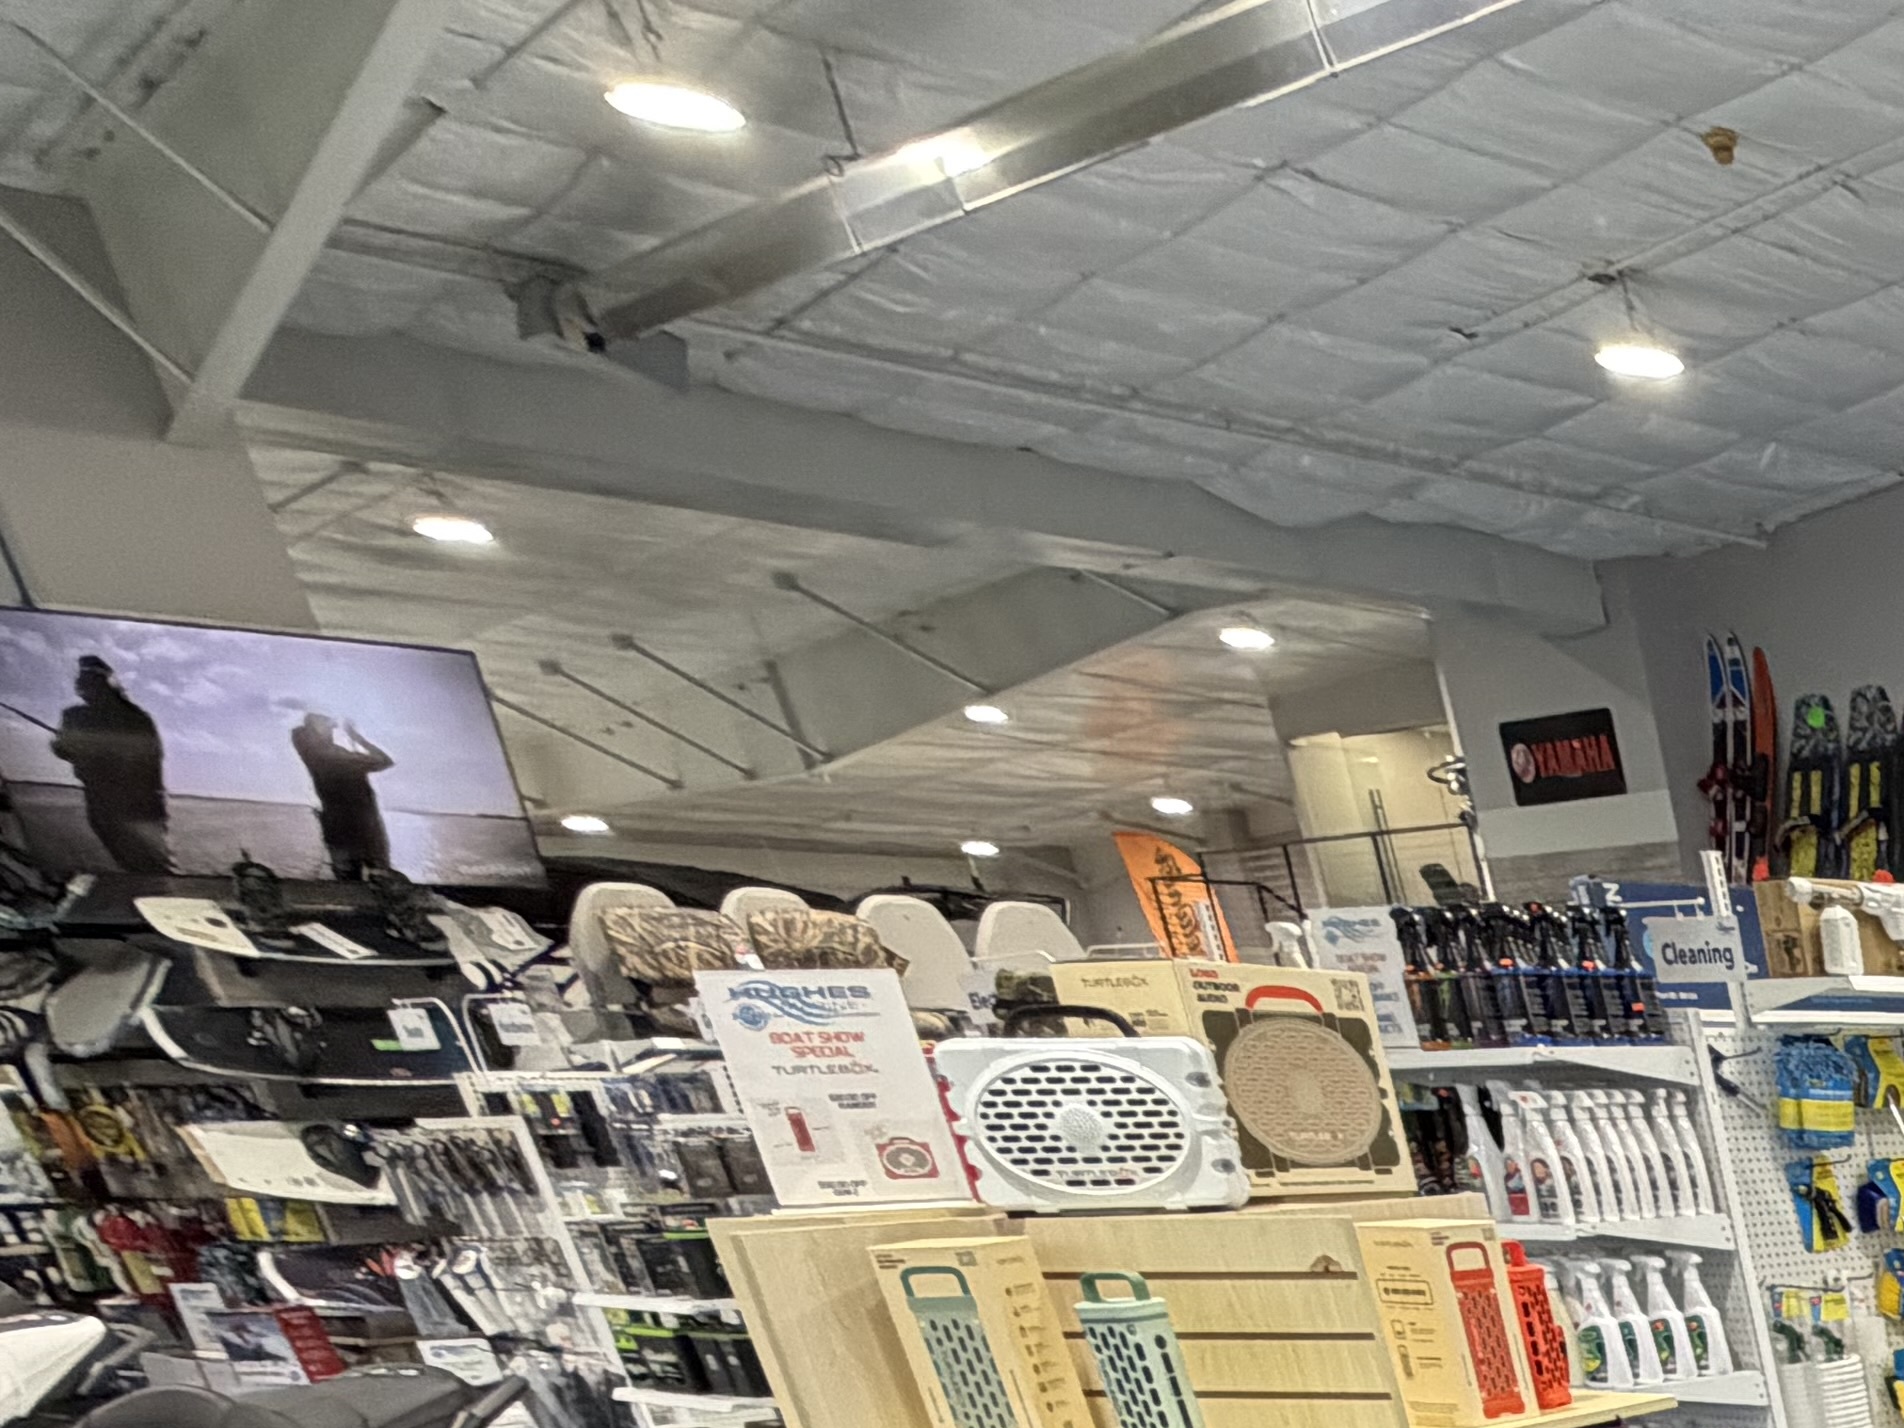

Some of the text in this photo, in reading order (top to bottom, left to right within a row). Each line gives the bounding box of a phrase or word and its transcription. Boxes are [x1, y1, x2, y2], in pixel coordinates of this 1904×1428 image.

[1531, 734, 1616, 778] YAMAHA
[1661, 941, 1735, 970] Cleaning
[728, 986, 871, 1000] HUGHES
[820, 1031, 864, 1043] SHOW
[790, 1046, 856, 1058] SPECIAL
